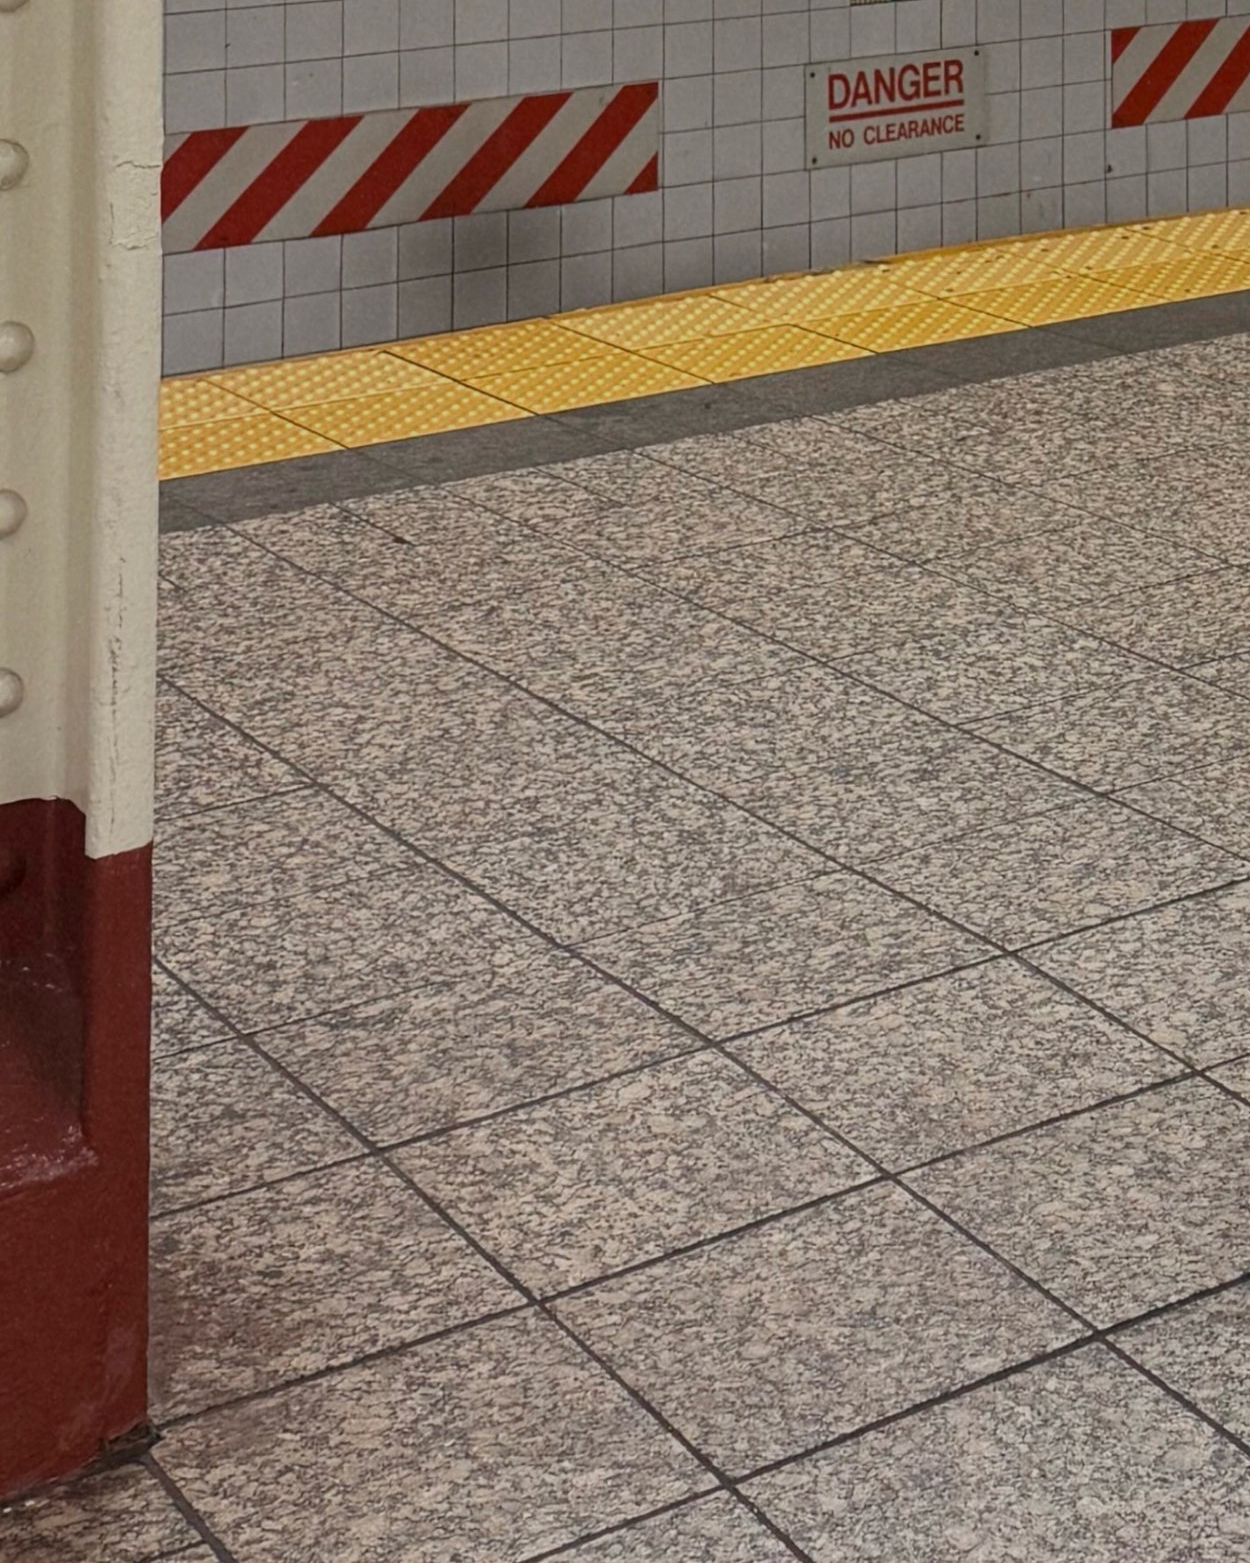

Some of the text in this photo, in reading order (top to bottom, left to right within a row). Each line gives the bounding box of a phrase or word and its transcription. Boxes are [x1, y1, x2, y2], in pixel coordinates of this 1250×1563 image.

[827, 58, 964, 110] DANGER
[828, 113, 966, 150] NO CLEARANCE
